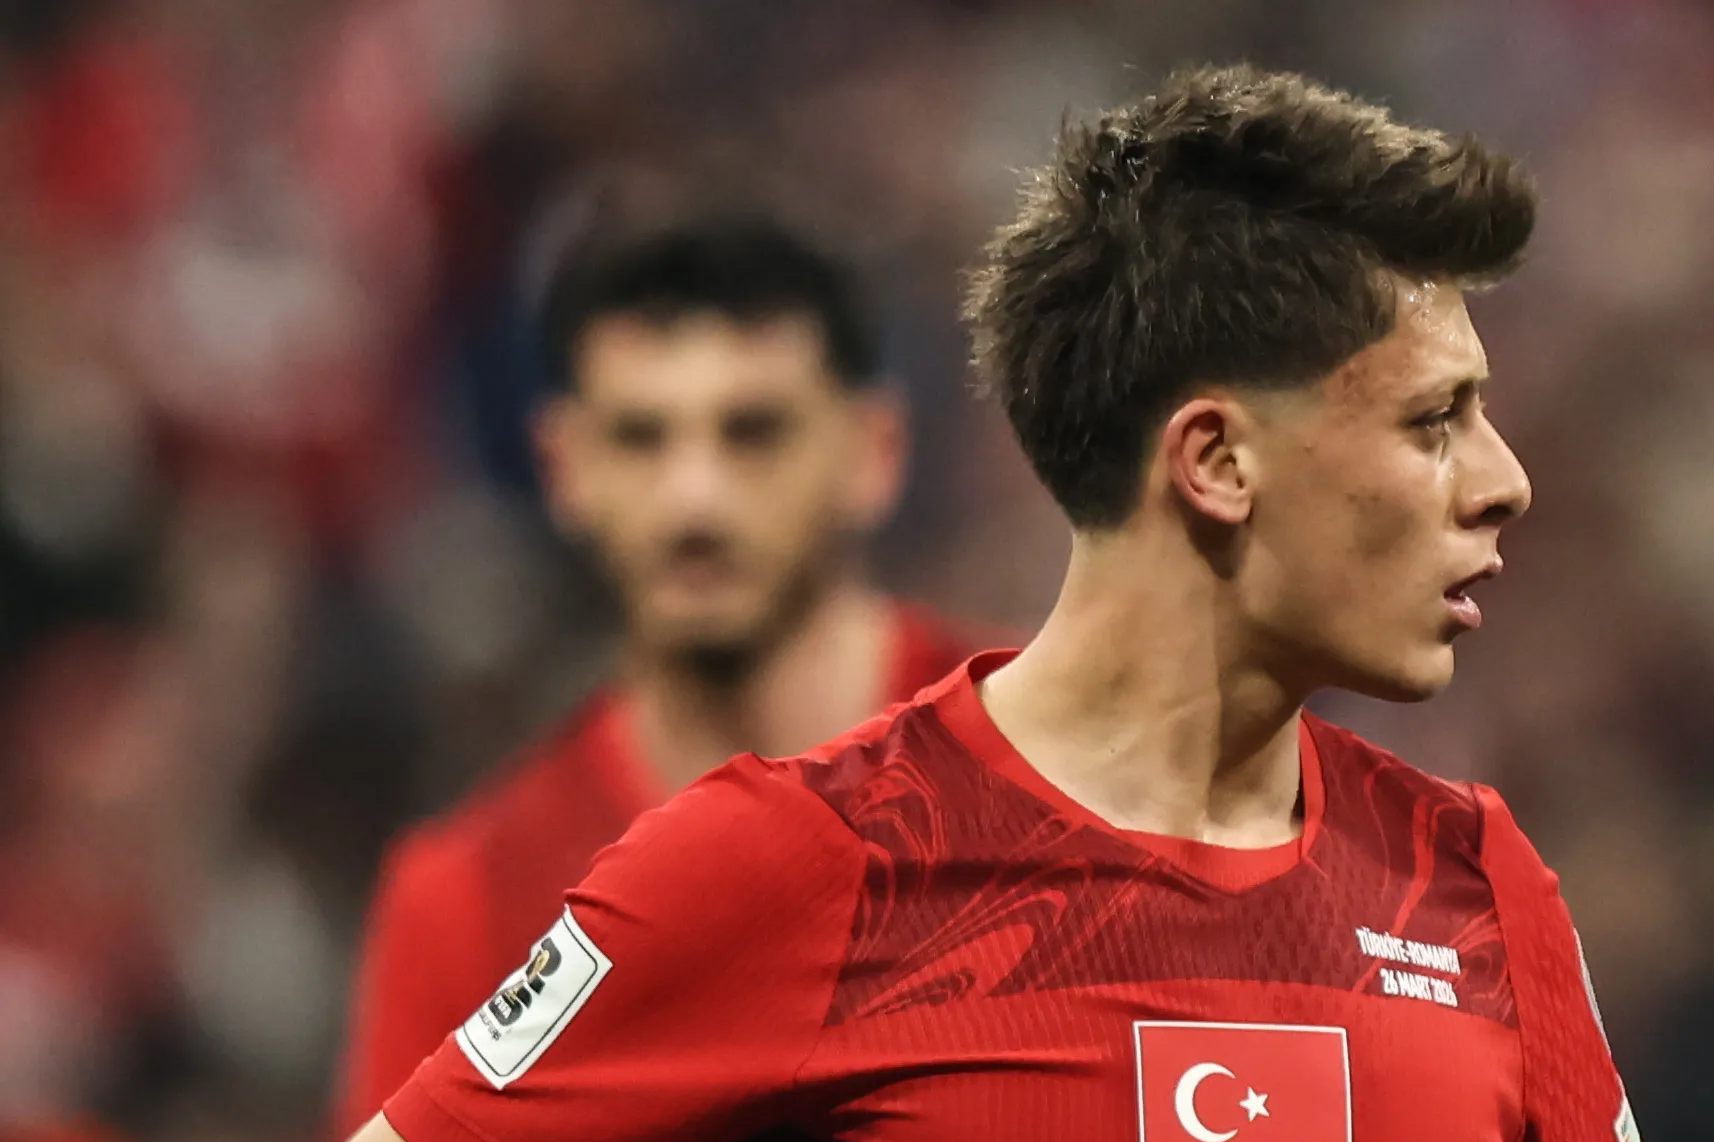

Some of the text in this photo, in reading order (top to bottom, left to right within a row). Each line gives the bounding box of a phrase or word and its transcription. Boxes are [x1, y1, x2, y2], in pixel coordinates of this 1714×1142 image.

[1355, 925, 1461, 976] TÜRKİYE-ROMANYA
[1379, 967, 1459, 1008] 26 MART 2026
